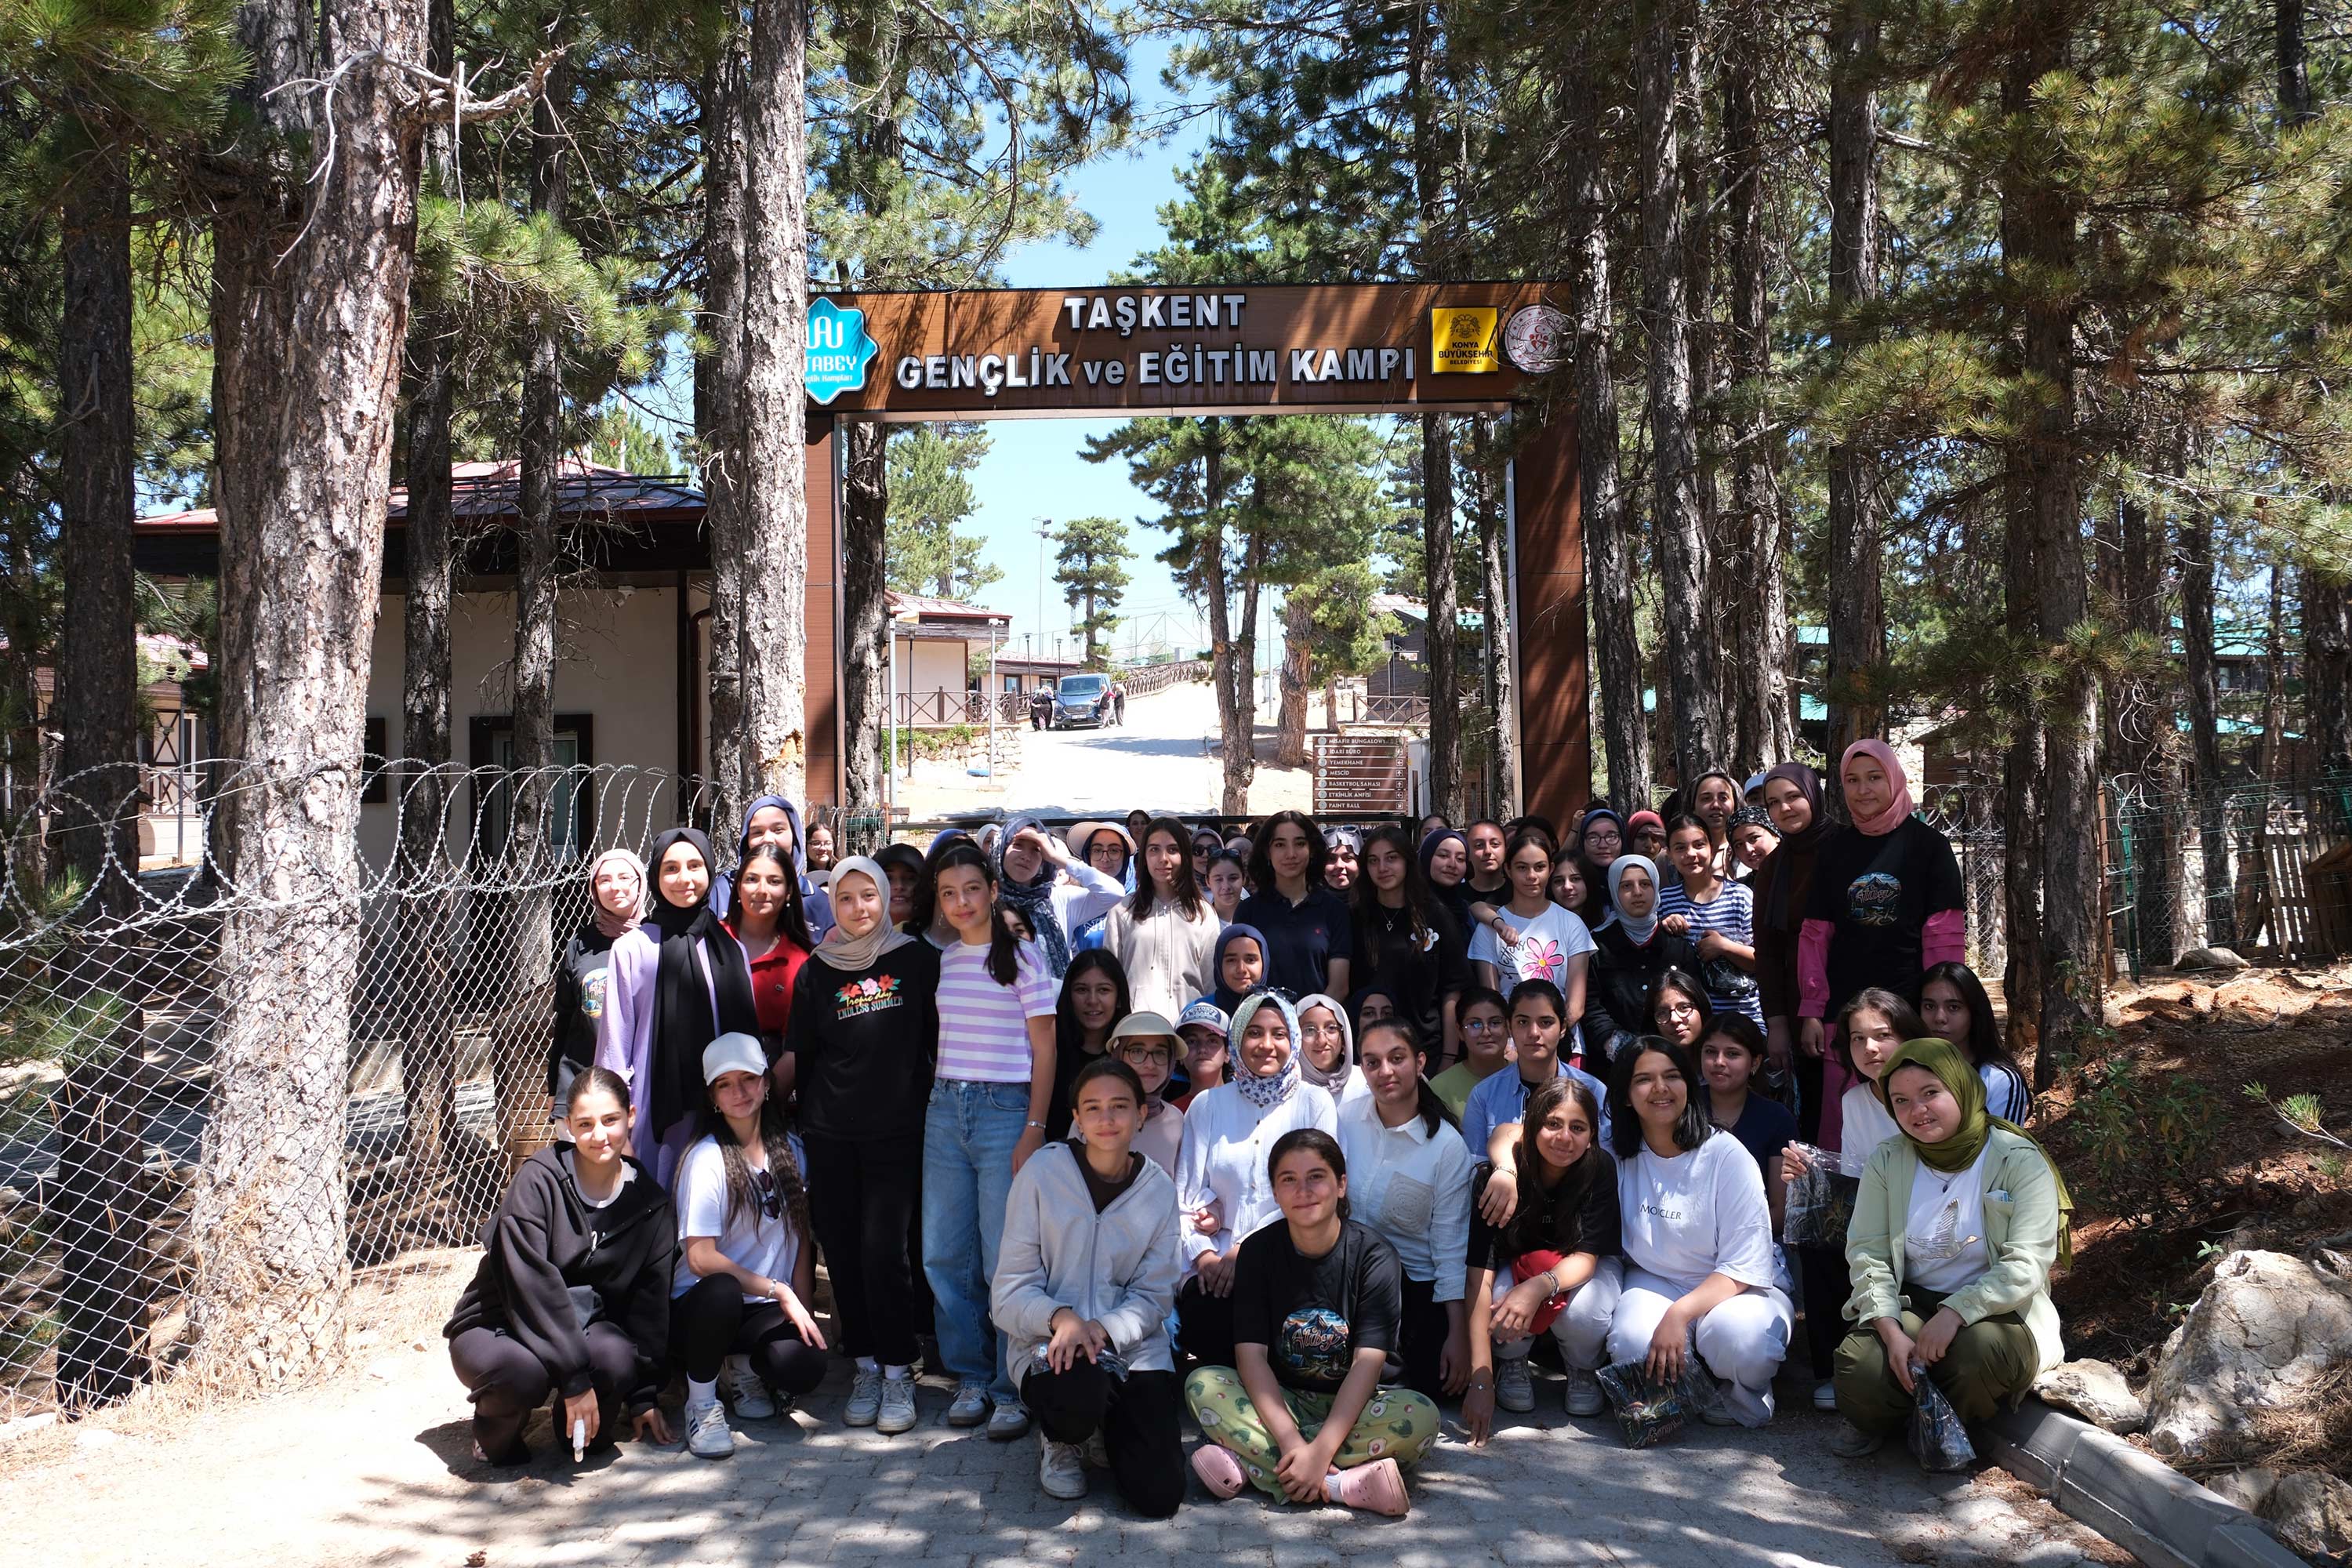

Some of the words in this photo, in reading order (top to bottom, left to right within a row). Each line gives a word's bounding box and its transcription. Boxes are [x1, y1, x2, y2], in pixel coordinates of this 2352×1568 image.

[1065, 294, 1245, 337] TAŞKENT
[806, 355, 857, 372] TABEY
[897, 346, 1070, 395] GENÇLİK
[1083, 361, 1127, 384] ve
[1139, 343, 1277, 386] EĞİTİM
[1290, 348, 1415, 383] KAMPI
[837, 1002, 869, 1020] ENDLESS
[871, 996, 903, 1012] SUMMER
[846, 995, 873, 1007] Tropic
[875, 991, 893, 1000] day
[1640, 1203, 1682, 1220] MOCLER
